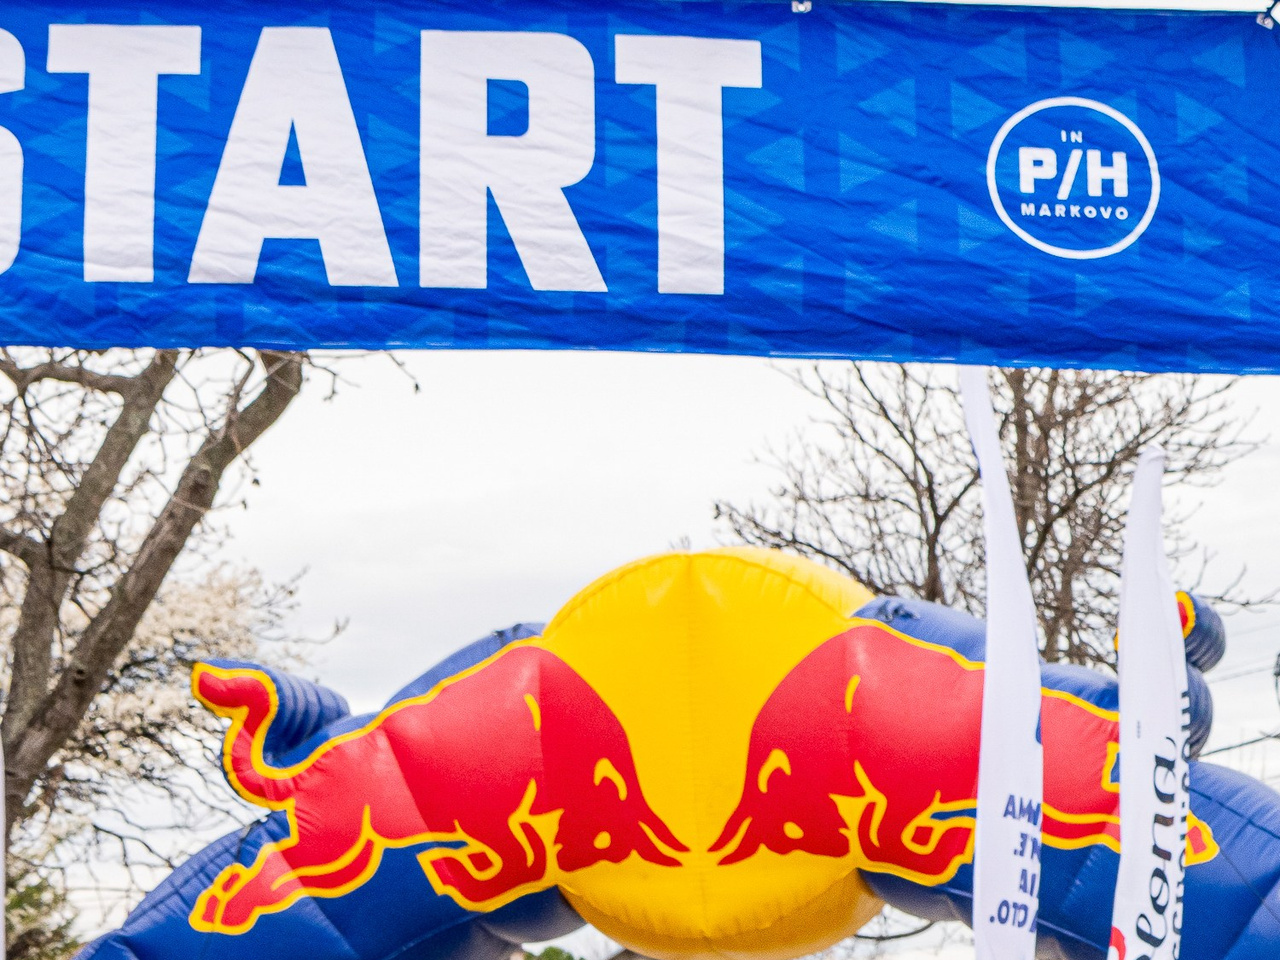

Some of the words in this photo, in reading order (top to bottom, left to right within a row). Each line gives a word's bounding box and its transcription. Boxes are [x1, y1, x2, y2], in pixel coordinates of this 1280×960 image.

[1060, 129, 1083, 143] IN
[0, 22, 763, 295] TART
[1018, 146, 1129, 200] P/H
[1020, 202, 1130, 220] MARKOVO
